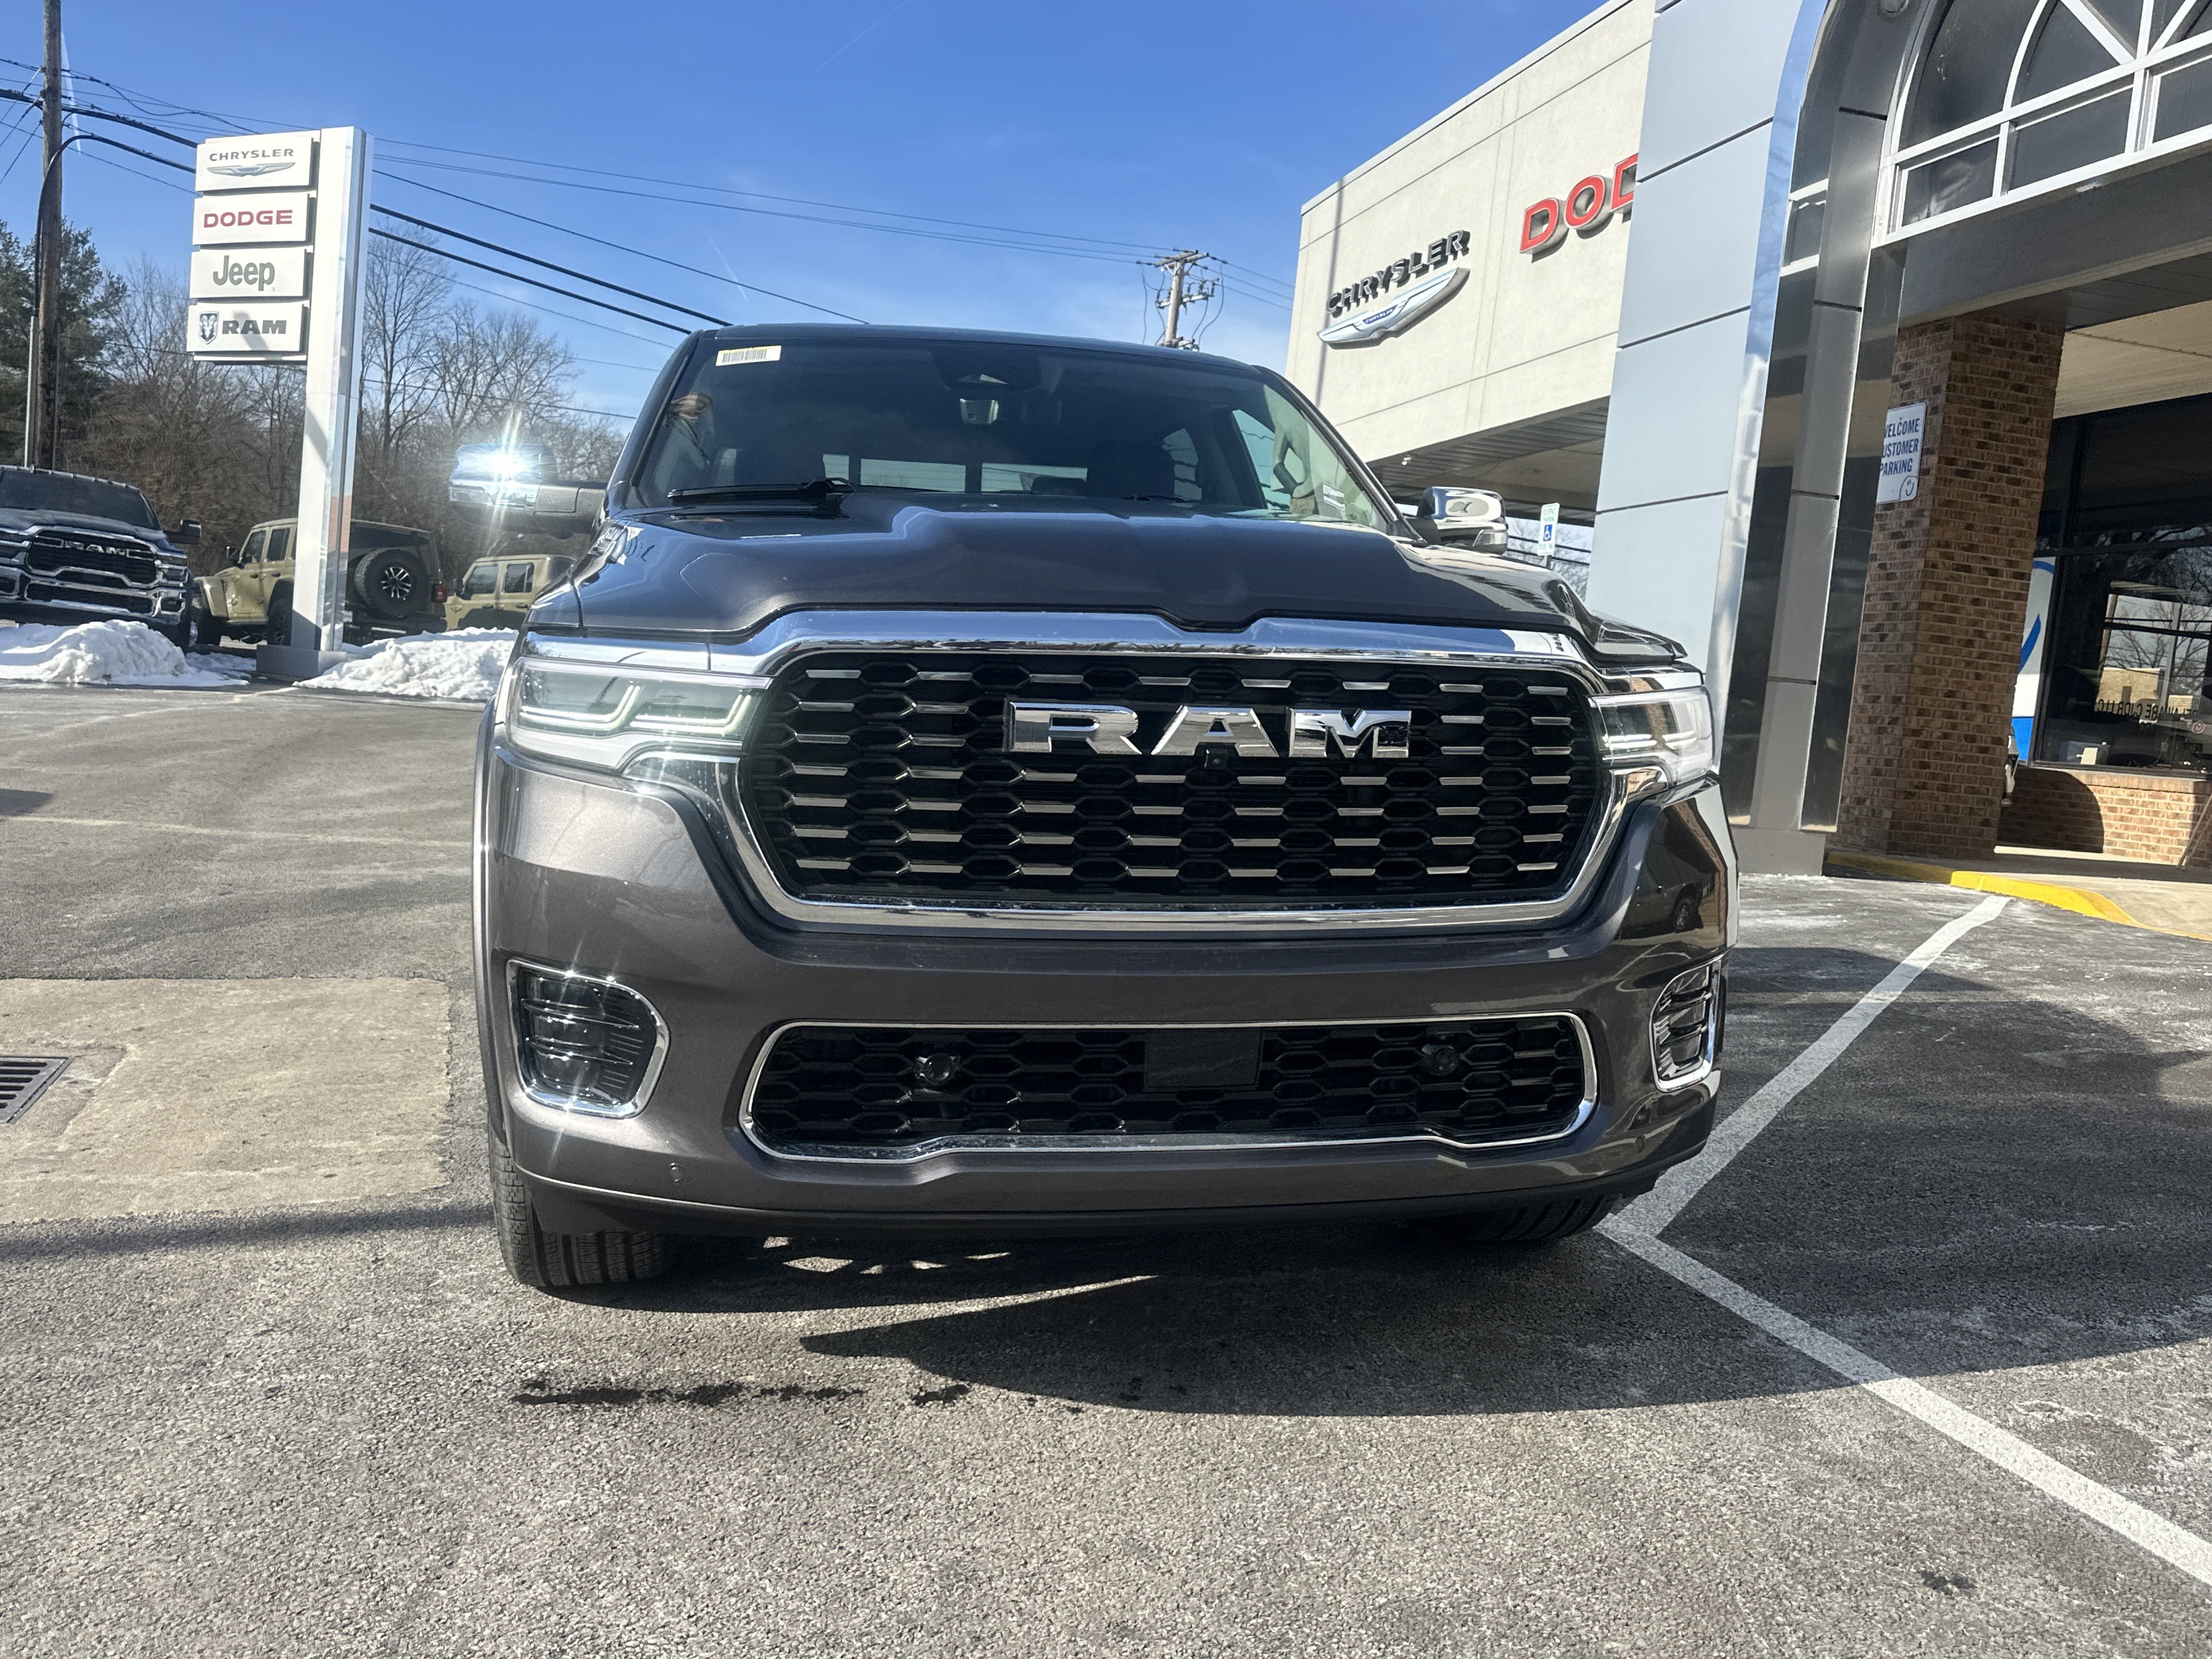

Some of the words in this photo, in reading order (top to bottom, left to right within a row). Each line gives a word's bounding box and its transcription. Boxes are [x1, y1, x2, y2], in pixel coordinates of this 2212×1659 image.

[209, 149, 294, 161] CHRYSLER
[204, 209, 293, 228] DODGE
[212, 255, 275, 291] Jeep
[1325, 229, 1466, 315] CHRYSLER
[222, 320, 287, 335] RAM
[1886, 418, 1920, 437] ELCOME
[64, 540, 126, 556] RAM
[1003, 698, 1413, 758] RAM
